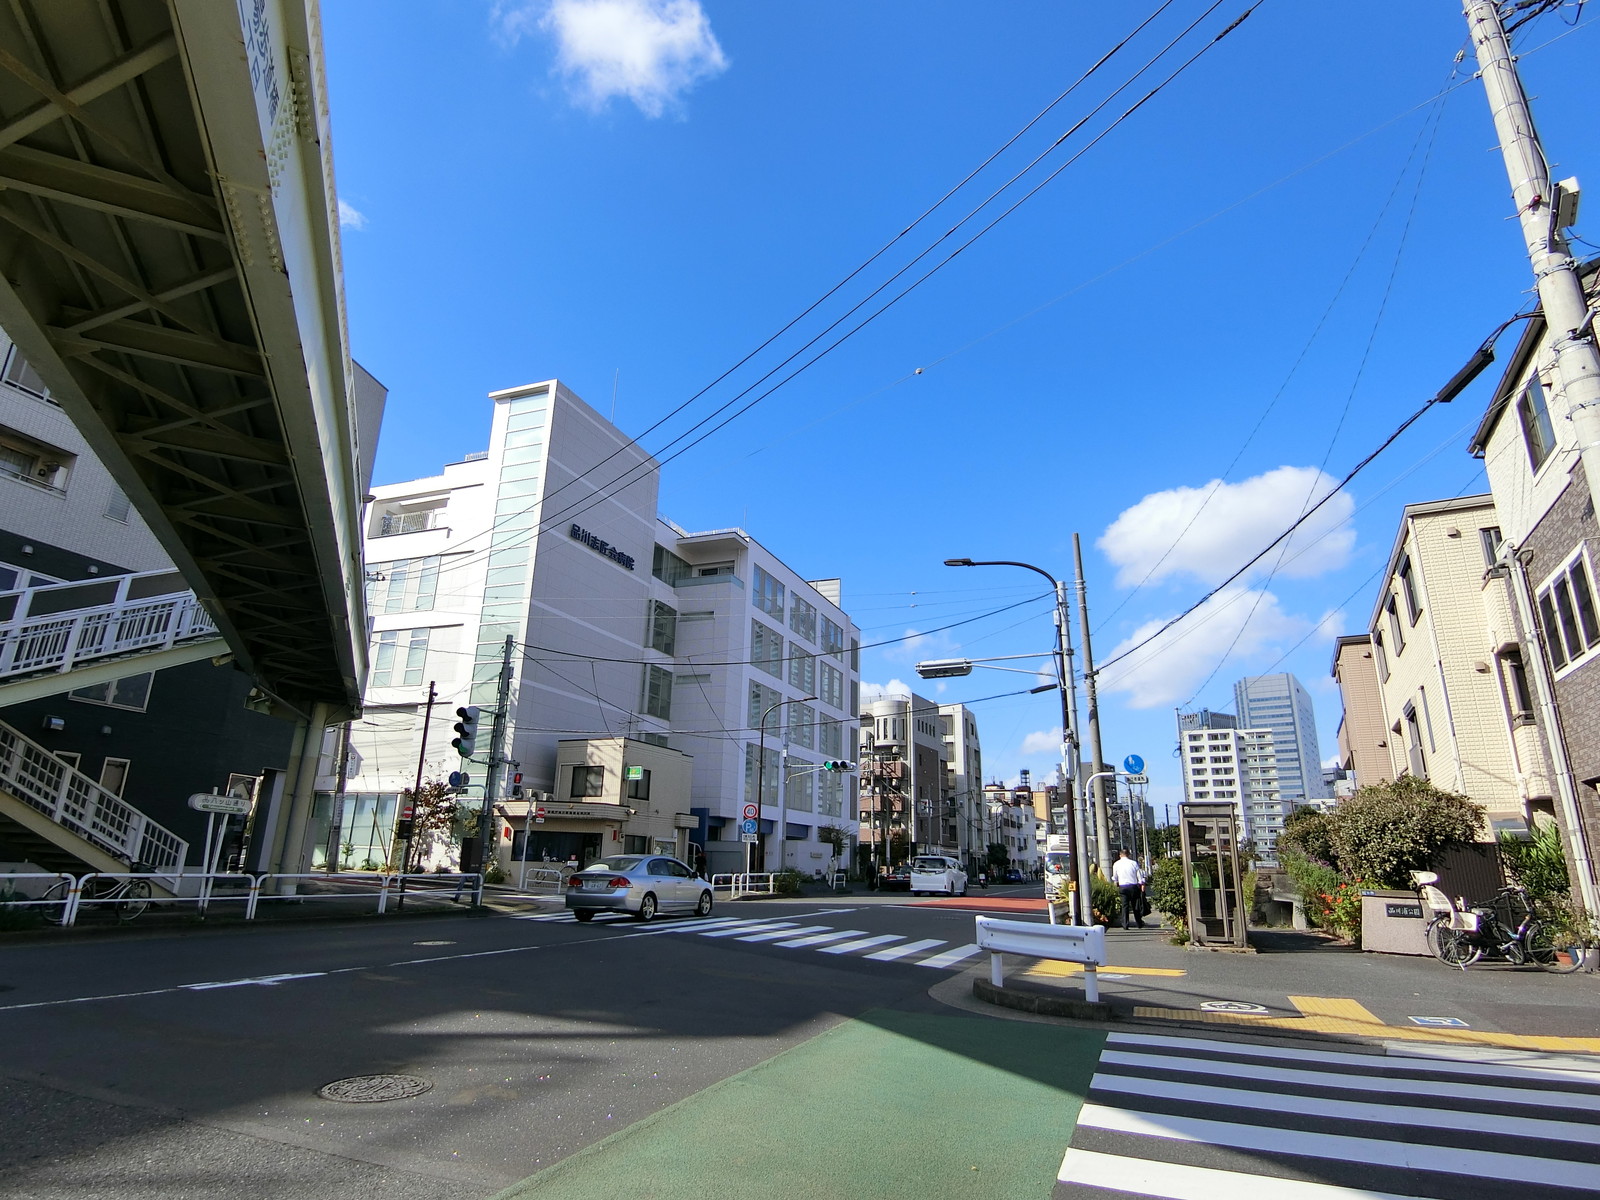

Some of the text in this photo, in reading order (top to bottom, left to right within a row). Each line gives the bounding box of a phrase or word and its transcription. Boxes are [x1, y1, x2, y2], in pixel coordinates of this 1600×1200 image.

[570, 523, 635, 571] 品川志匠会病院
[746, 807, 755, 815] 40
